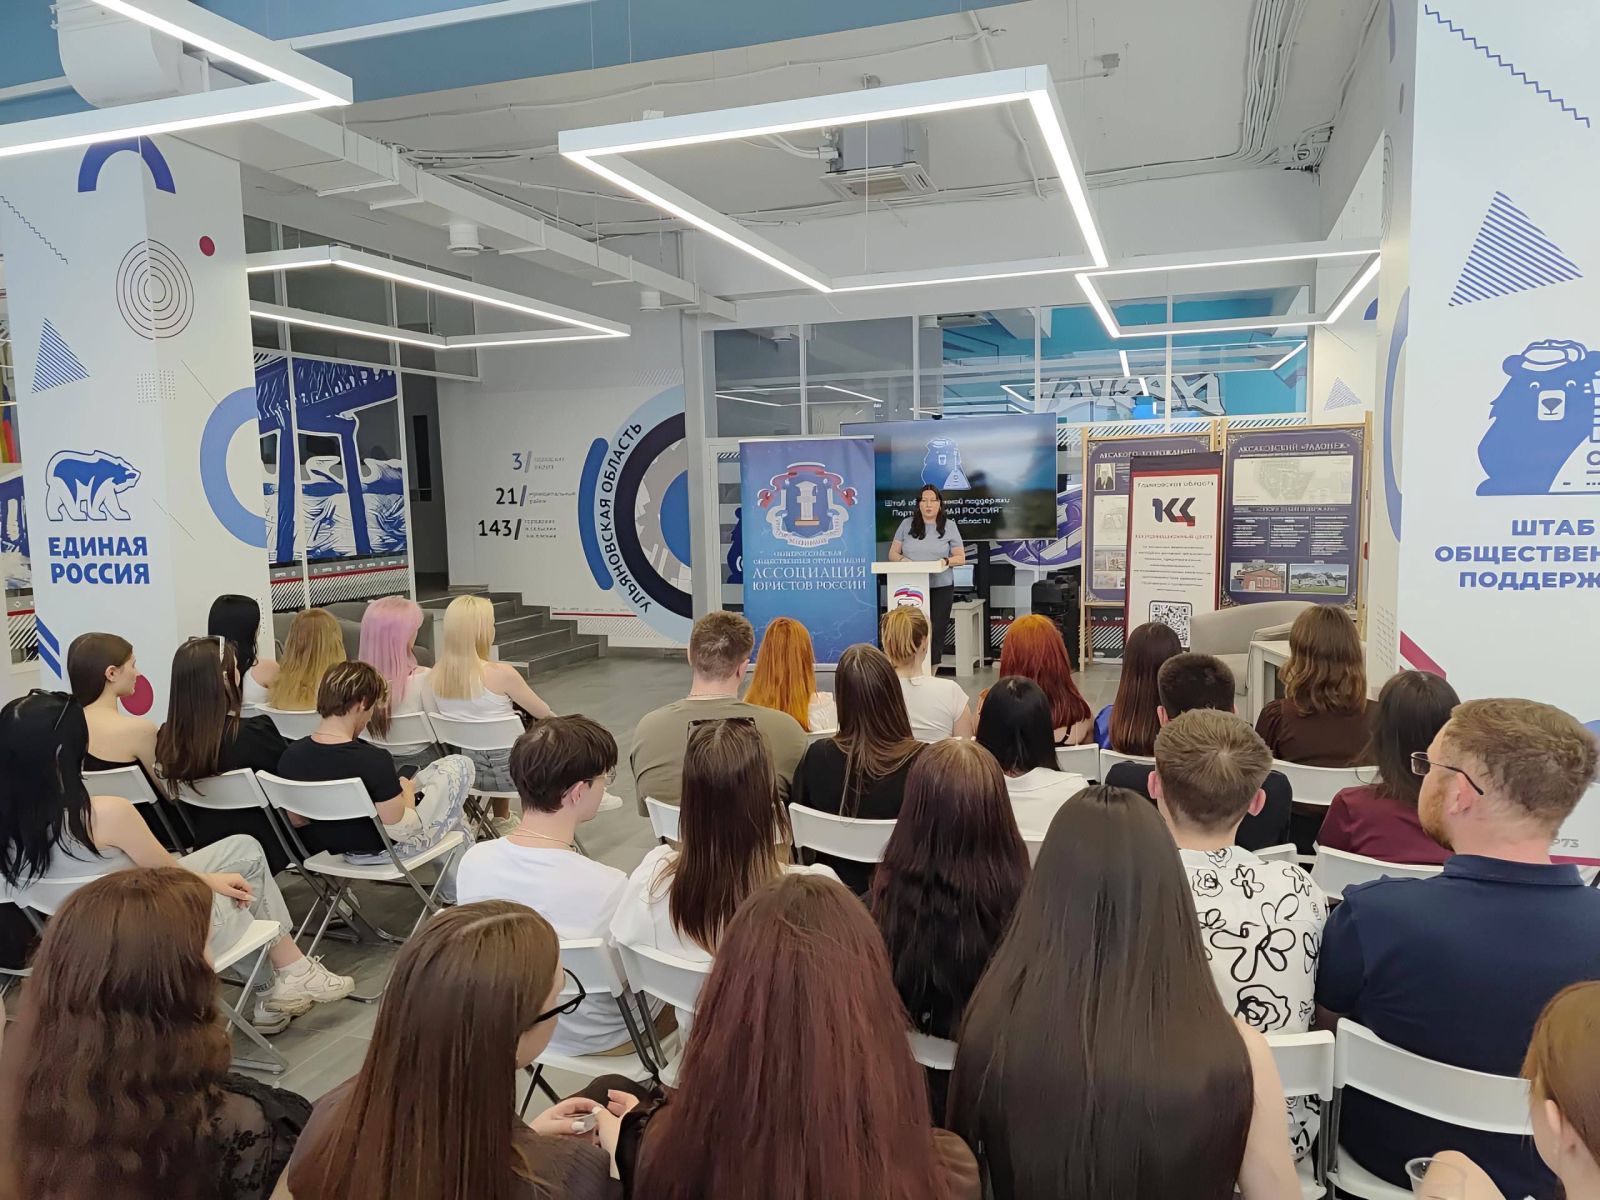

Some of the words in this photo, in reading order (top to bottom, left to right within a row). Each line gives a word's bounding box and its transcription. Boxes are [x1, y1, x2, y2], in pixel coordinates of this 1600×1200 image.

[602, 422, 642, 493] ОБЛАСТЬ
[1511, 519, 1596, 537] ШТАБ
[48, 536, 148, 558] ЕДИНАЯ
[600, 499, 652, 614] УЛЬЯНОВСКАЯ
[50, 562, 150, 585] РОССИЯ
[752, 566, 866, 580] АССОЦИАЦИЯ
[752, 581, 813, 591] ЮРИСТОВ
[816, 580, 866, 591] РОССИИ
